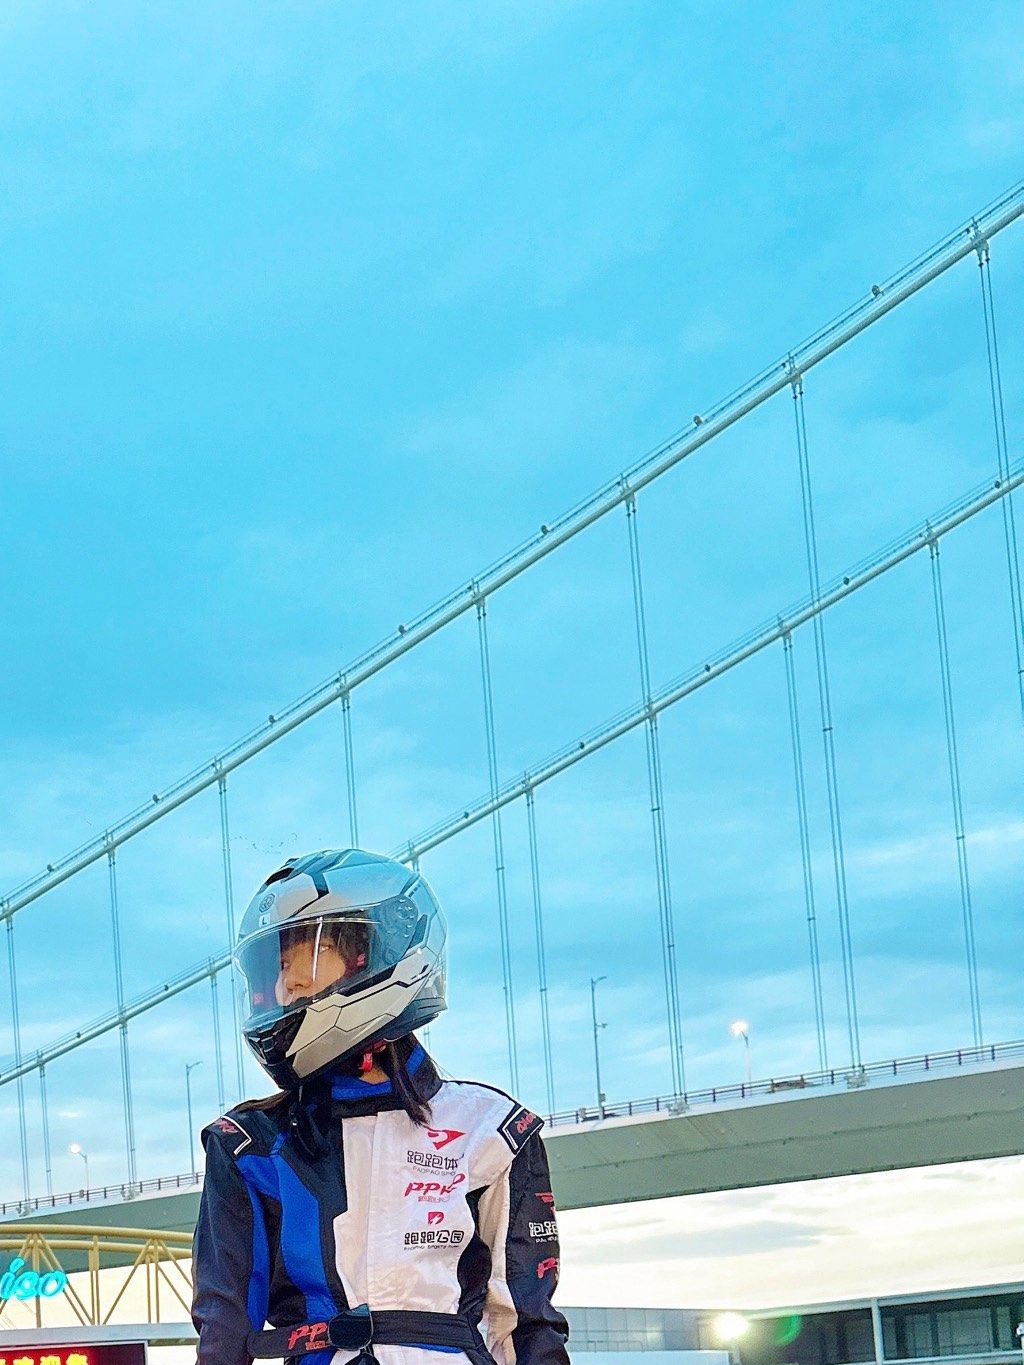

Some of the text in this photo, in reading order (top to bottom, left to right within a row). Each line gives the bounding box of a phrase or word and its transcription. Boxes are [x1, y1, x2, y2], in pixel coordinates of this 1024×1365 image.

[407, 1150, 464, 1170] 跑跑体
[404, 1229, 465, 1246] 跑跑公园
